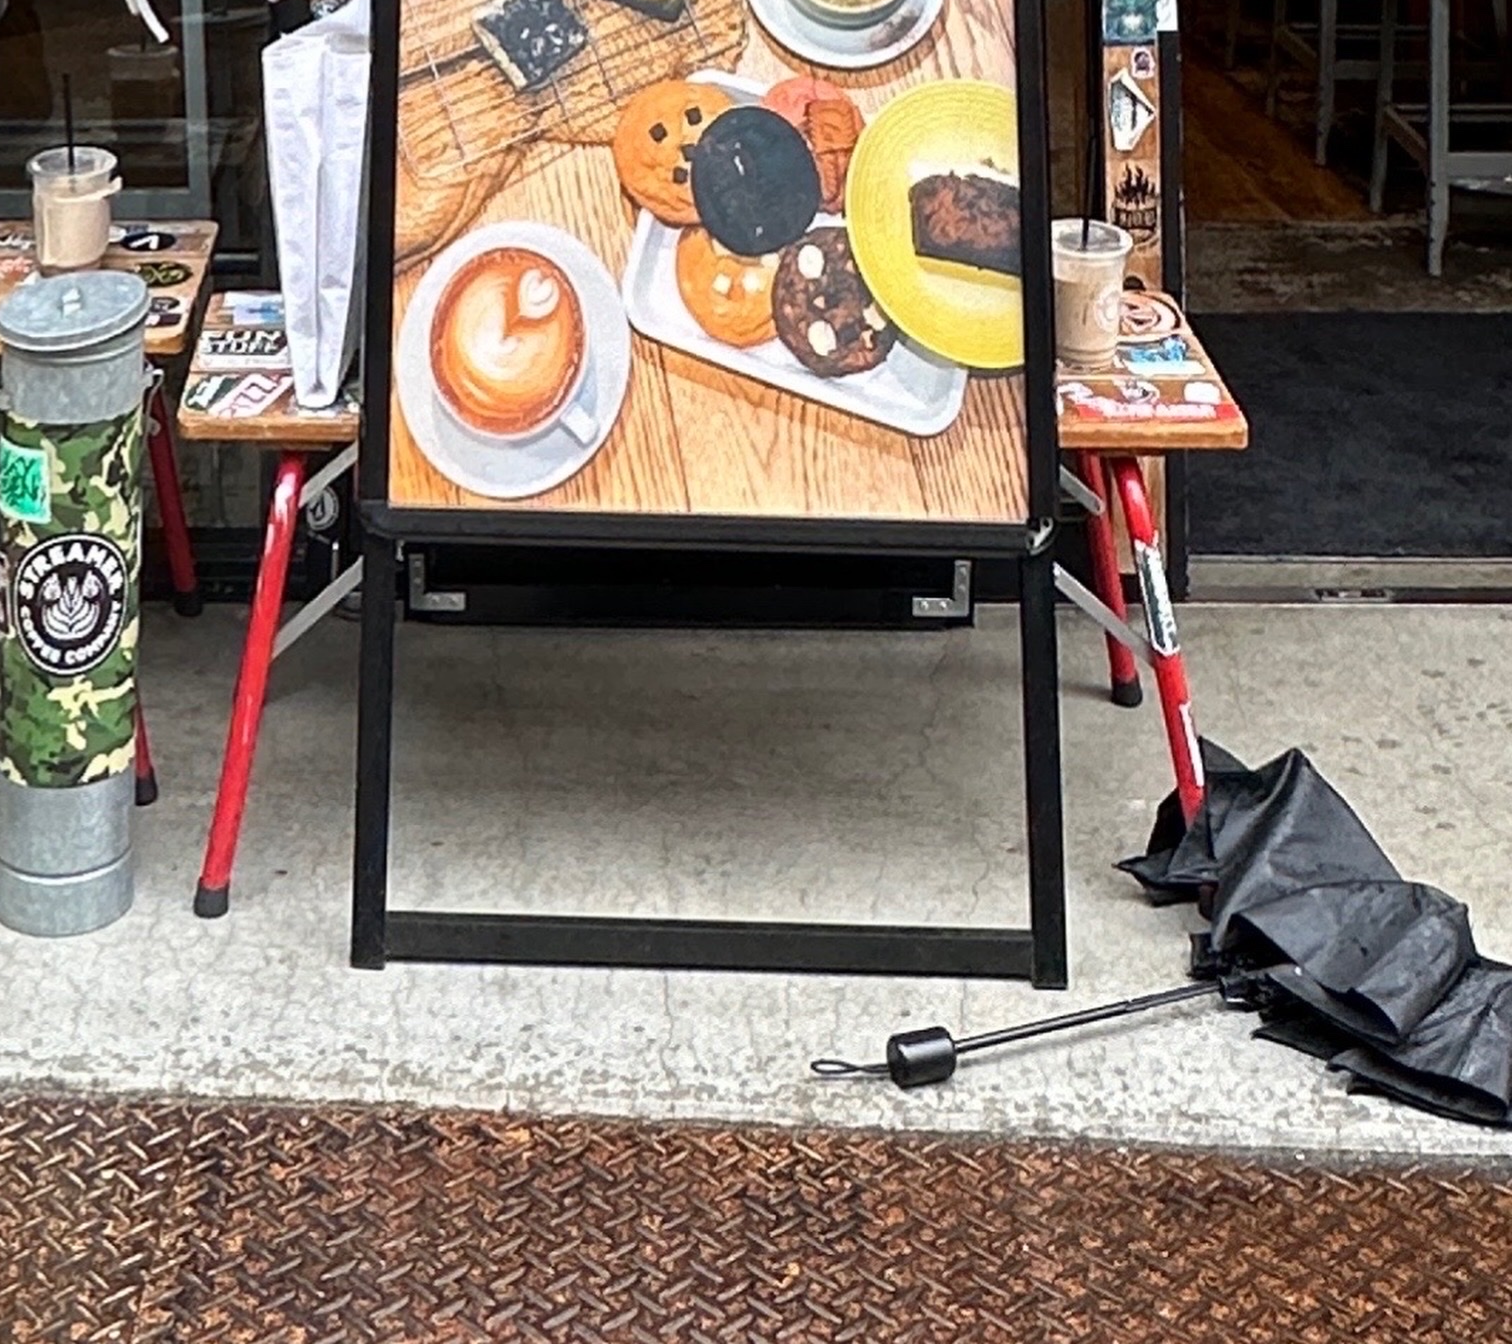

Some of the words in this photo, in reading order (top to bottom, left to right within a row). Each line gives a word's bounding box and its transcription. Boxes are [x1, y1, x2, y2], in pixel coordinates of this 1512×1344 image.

[19, 542, 124, 600] STREAMER
[19, 604, 62, 665] COFFEE
[64, 605, 122, 666] COMPANY
